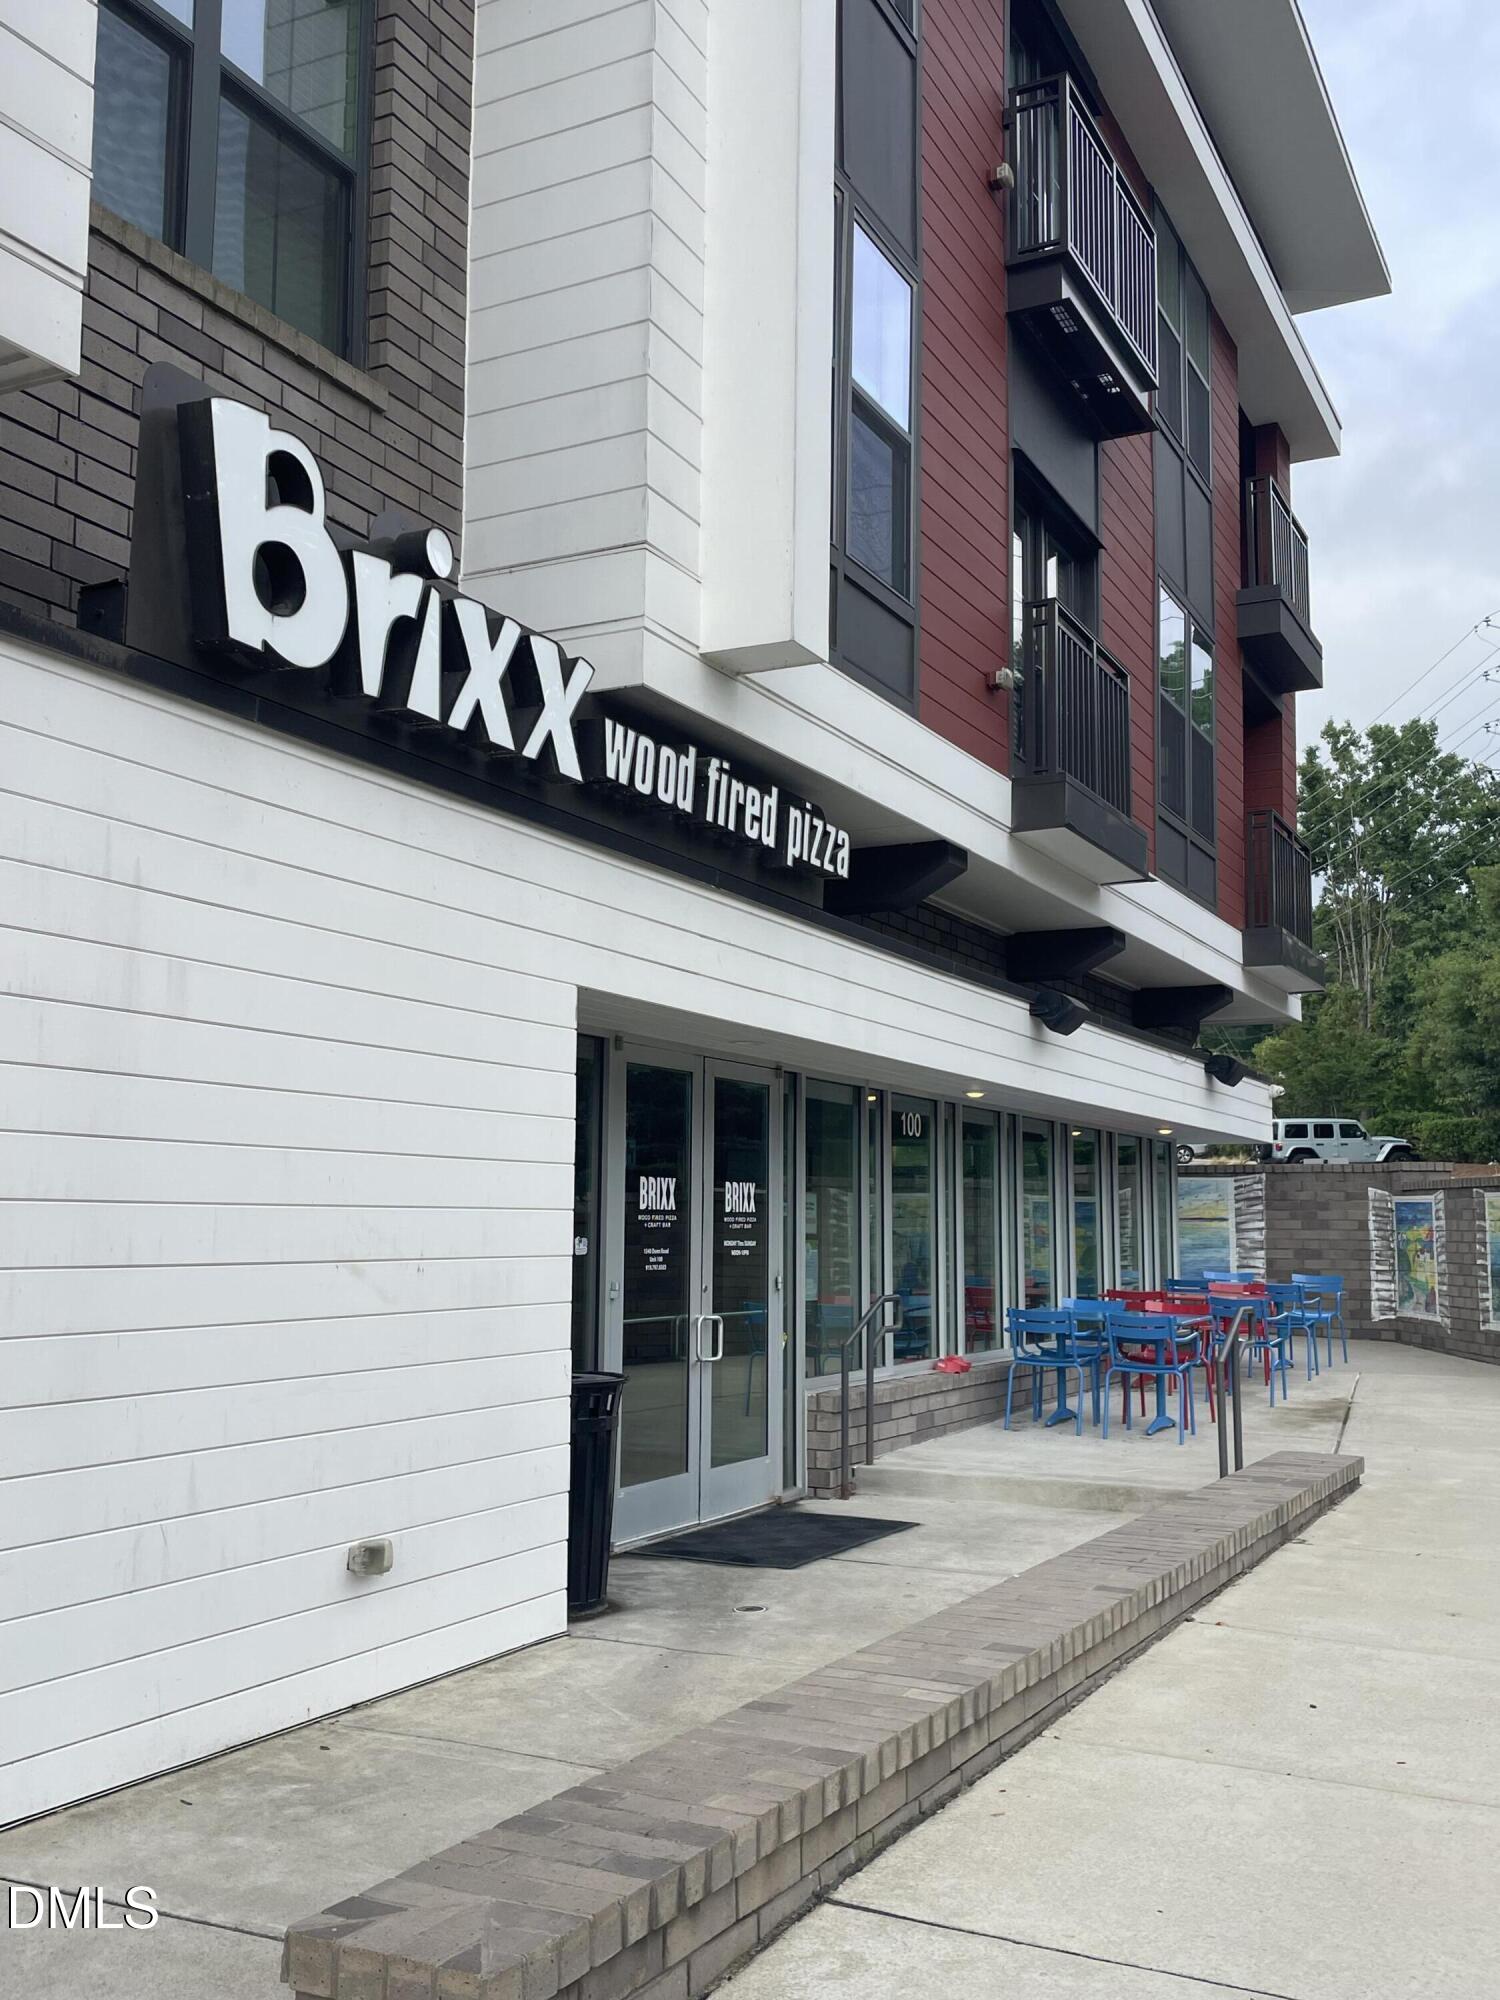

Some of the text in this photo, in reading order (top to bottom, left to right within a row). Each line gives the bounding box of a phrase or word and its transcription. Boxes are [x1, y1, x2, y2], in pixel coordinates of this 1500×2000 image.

[604, 716, 851, 880] wood fired pizza
[901, 1111, 922, 1138] 100
[639, 1176, 677, 1210] BRIXX
[725, 1181, 756, 1213] BRIXX
